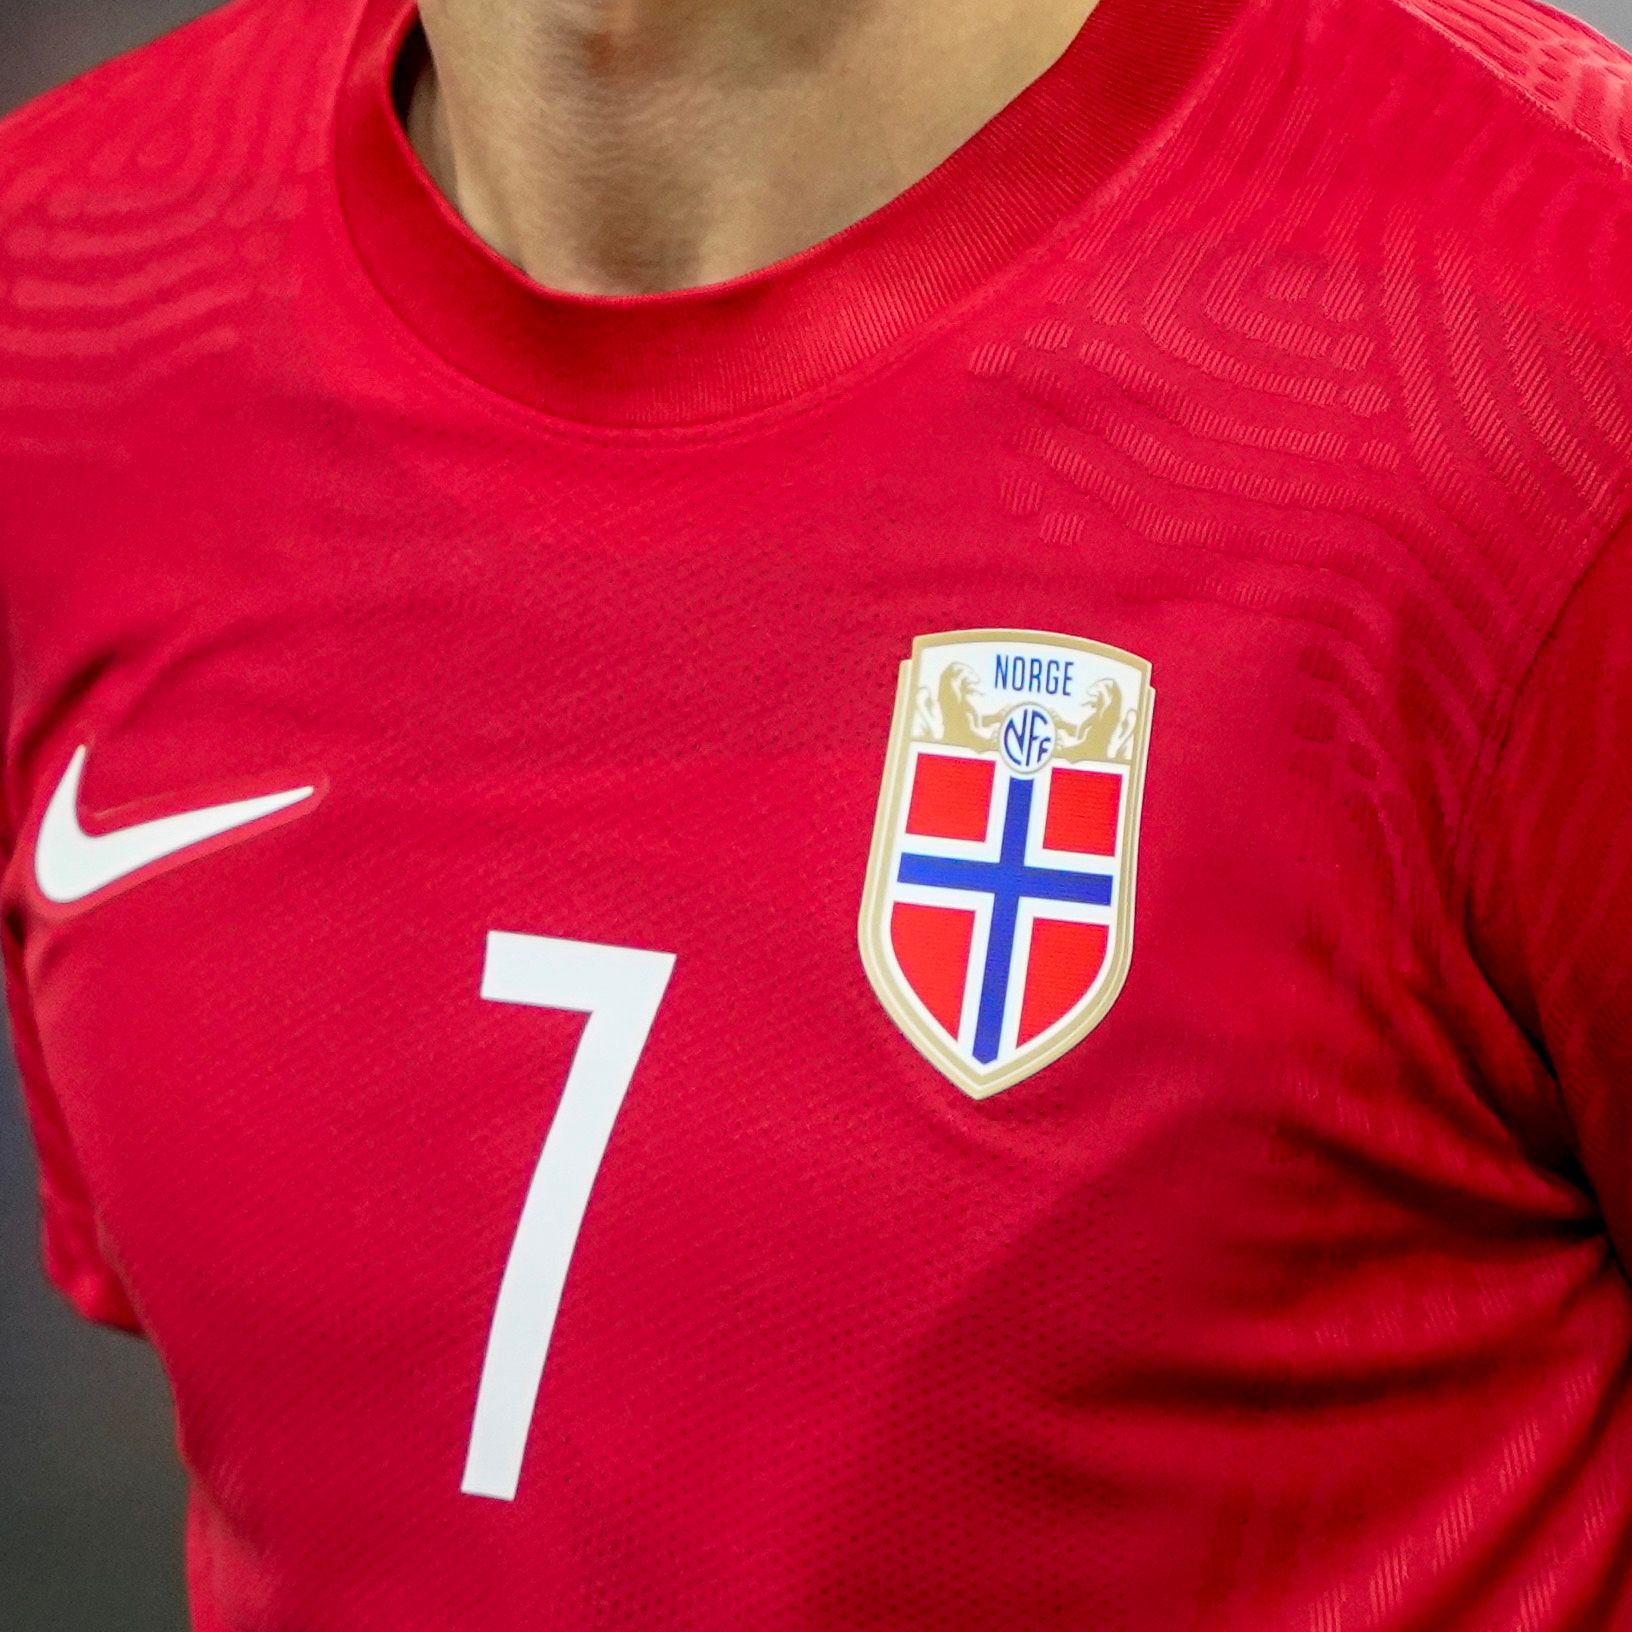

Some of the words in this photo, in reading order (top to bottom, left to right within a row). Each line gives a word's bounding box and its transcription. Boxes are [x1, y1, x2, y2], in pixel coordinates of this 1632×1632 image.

[994, 654, 1074, 697] NORGE
[1004, 708, 1051, 767] NFF
[461, 930, 677, 1501] 7
